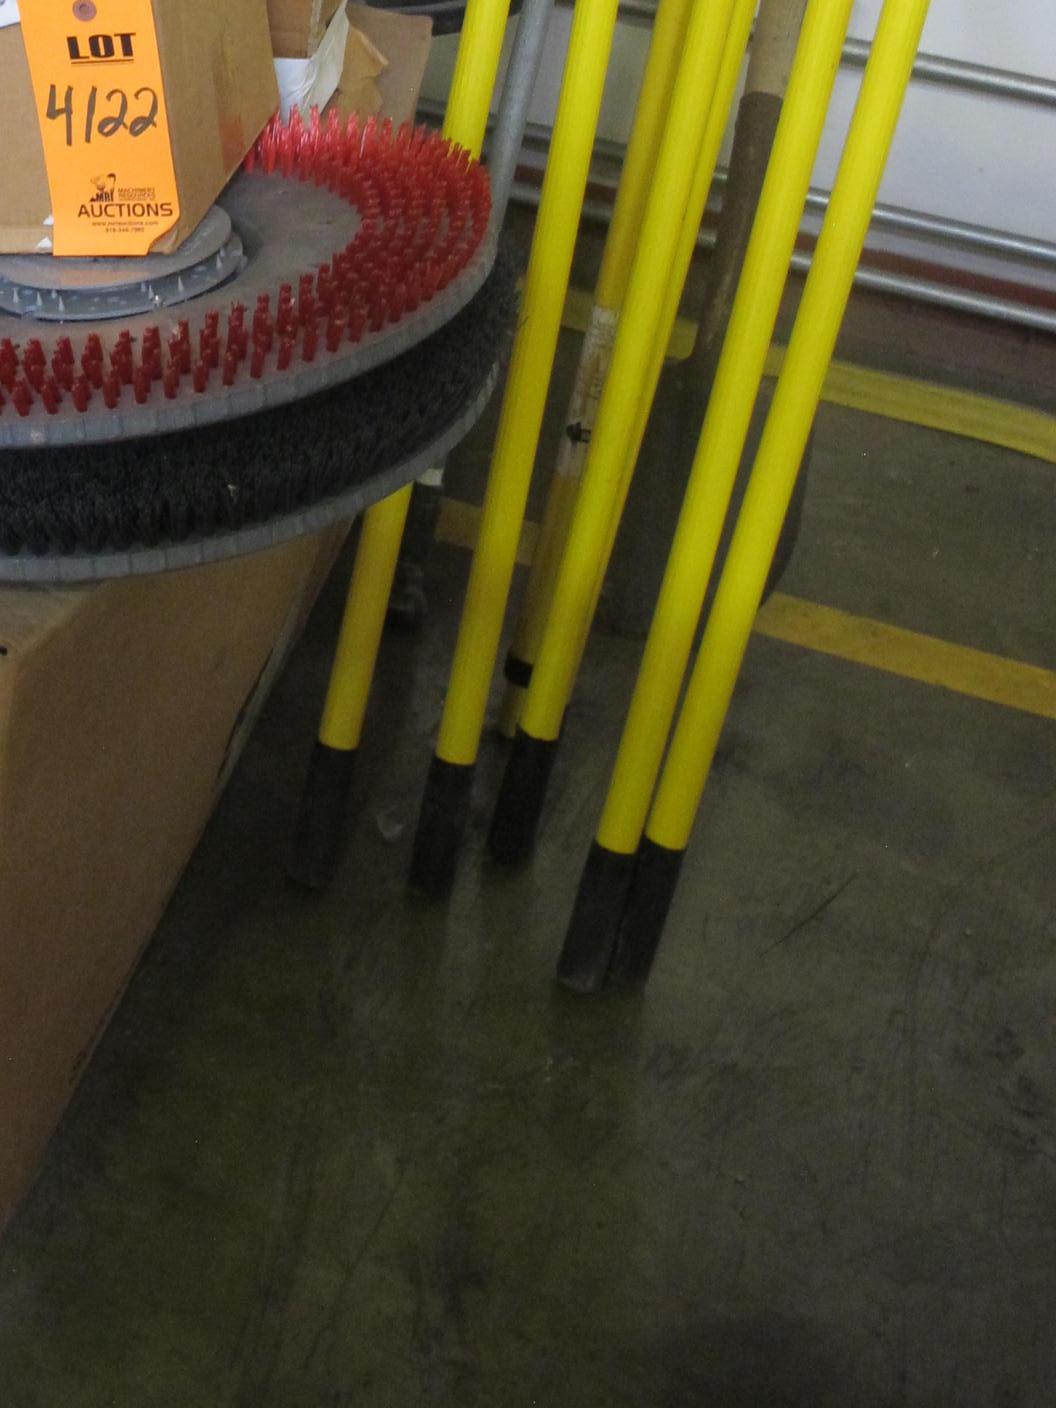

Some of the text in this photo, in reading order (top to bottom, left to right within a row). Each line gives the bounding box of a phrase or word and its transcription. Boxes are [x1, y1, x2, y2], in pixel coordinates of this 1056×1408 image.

[66, 32, 136, 60] LOT
[46, 83, 159, 147] 4122
[77, 201, 174, 219] AUCTIONS
